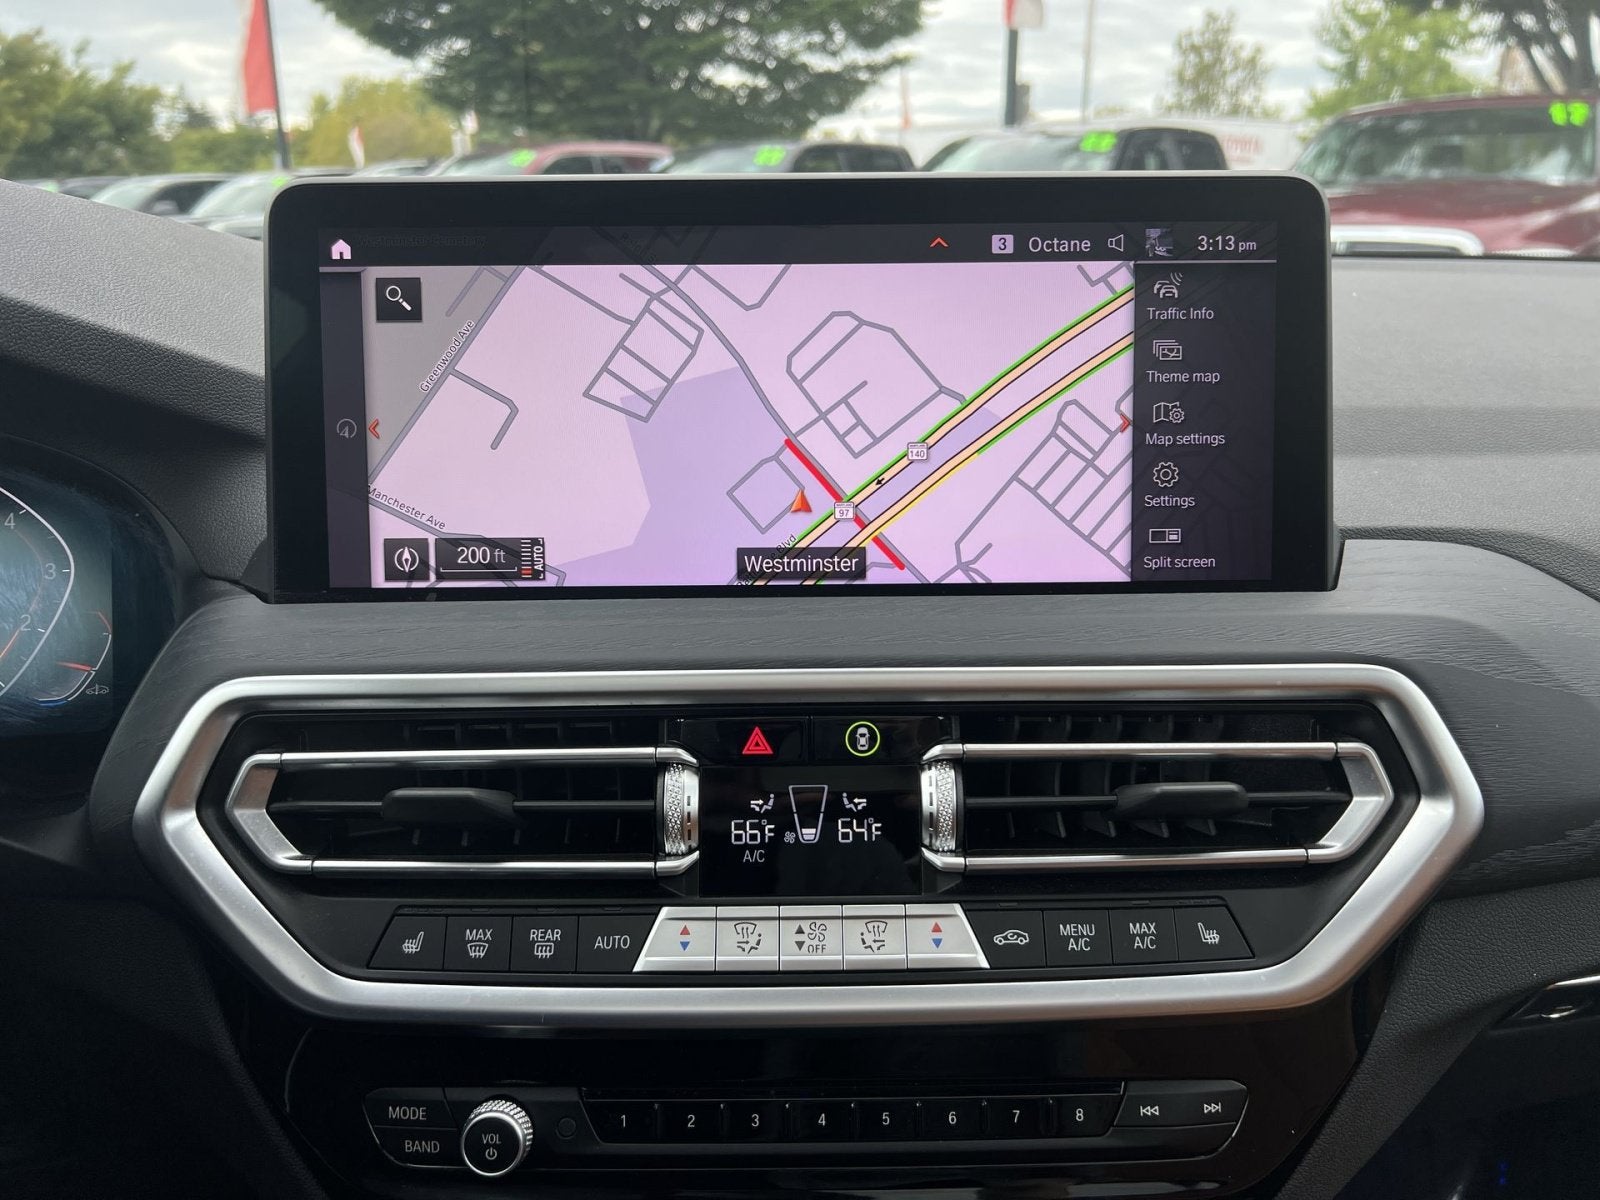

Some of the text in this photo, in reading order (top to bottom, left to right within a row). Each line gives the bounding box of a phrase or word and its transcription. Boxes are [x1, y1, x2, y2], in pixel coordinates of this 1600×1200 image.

[997, 237, 1008, 251] 3
[1028, 236, 1091, 252] Octane
[1197, 236, 1257, 252] 3:13 pm
[1147, 307, 1214, 320] Traffic Info
[420, 321, 475, 392] Greenwood Ave
[1146, 370, 1221, 385] Theme map
[1145, 433, 1226, 447] Map settings
[909, 450, 925, 458] 140
[367, 485, 446, 530] Manchester Ave
[1144, 495, 1195, 509] Settings
[838, 509, 849, 517] 97
[4, 513, 16, 529] 4
[776, 533, 797, 554] Blvd
[457, 547, 506, 564] 200 ft
[533, 545, 544, 571] AUTO
[744, 555, 860, 573] Westminster
[1144, 556, 1216, 570] Split screen
[44, 563, 57, 580] 3
[20, 614, 32, 631] 2
[743, 849, 765, 863] A/C
[465, 929, 492, 941] MAX
[530, 929, 561, 941] REAR
[1059, 923, 1096, 937] MENU
[1129, 922, 1156, 935] MAX
[594, 935, 630, 949] AUTO
[807, 944, 826, 954] OFF
[1068, 937, 1091, 951] A/C
[1134, 936, 1157, 950] A/C
[388, 1106, 427, 1121] MODE
[751, 1114, 760, 1127] 3
[817, 1113, 827, 1127] 4
[882, 1112, 891, 1126] 5
[948, 1111, 957, 1125] 6
[1012, 1110, 1021, 1123] 7
[1075, 1108, 1084, 1122] 8
[687, 1114, 696, 1128] 2
[482, 1133, 502, 1145] VOL
[404, 1139, 440, 1154] BAND
